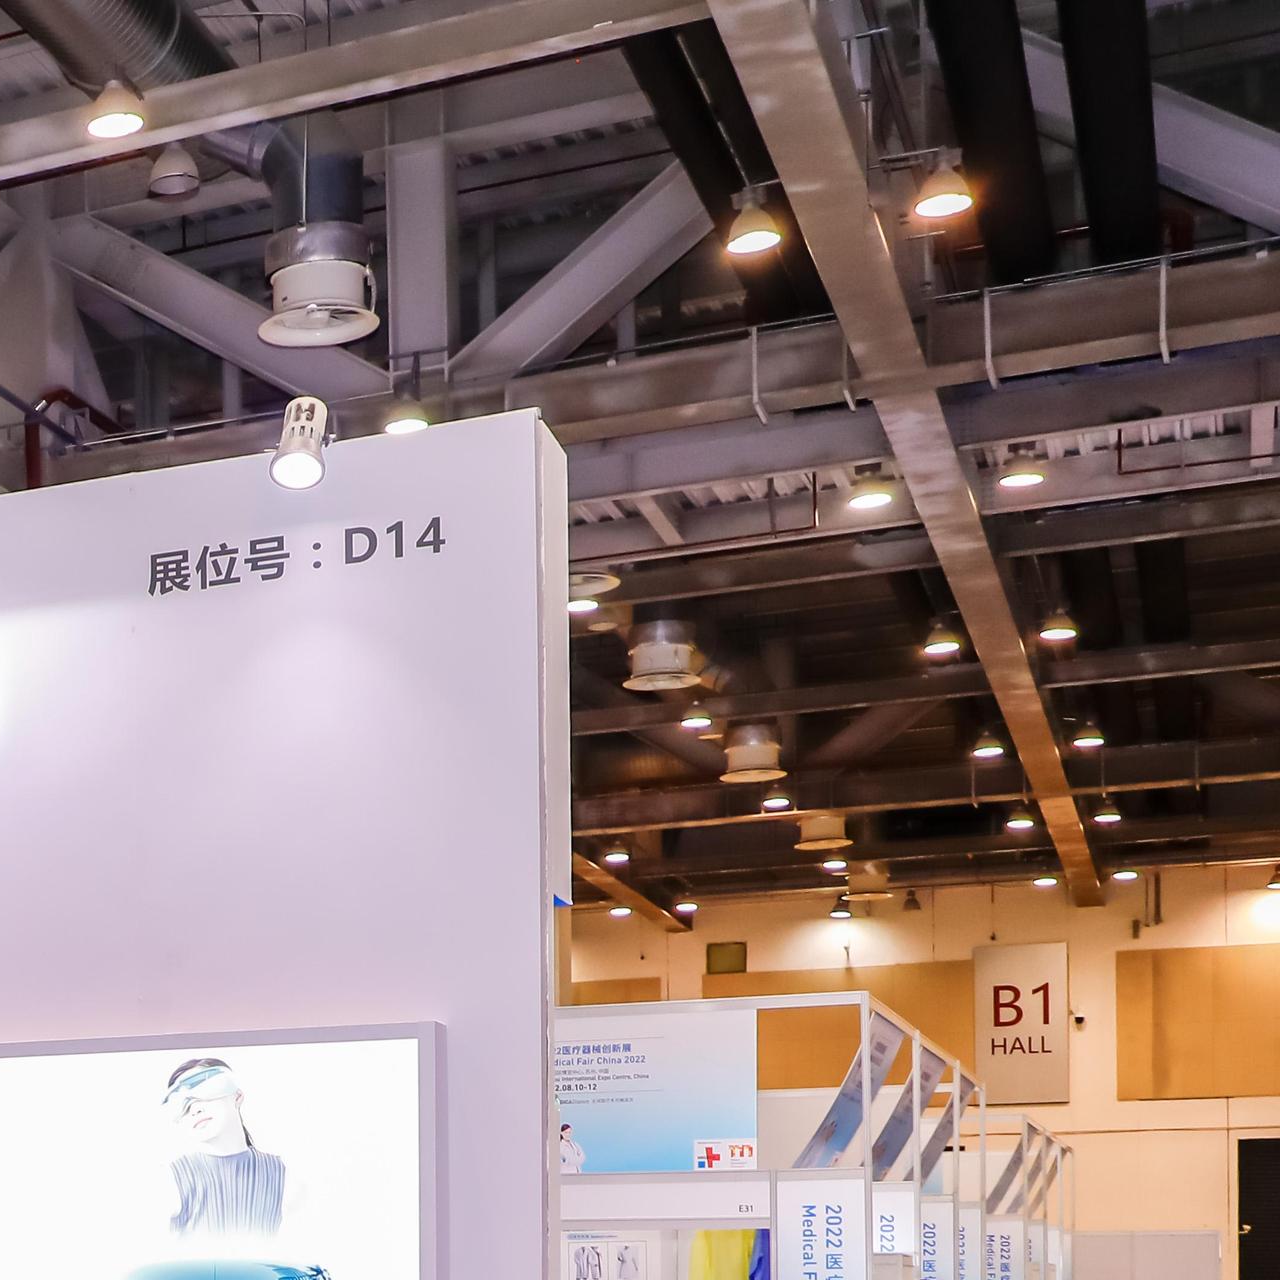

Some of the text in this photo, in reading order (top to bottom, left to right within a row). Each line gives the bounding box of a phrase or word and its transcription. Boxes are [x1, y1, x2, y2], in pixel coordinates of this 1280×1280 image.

[991, 982, 1051, 1028] B1
[577, 1057, 593, 1066] Fair
[597, 1056, 622, 1065] China
[624, 1055, 646, 1063] 2022
[990, 1036, 1052, 1056] HALL
[739, 1205, 753, 1213] E31
[802, 1205, 816, 1267] Medical
[825, 1205, 842, 1248] 2022
[880, 1215, 895, 1252] 2022
[923, 1223, 936, 1256] 2022
[987, 1234, 996, 1270] Medical
[1000, 1235, 1010, 1260] 2022
